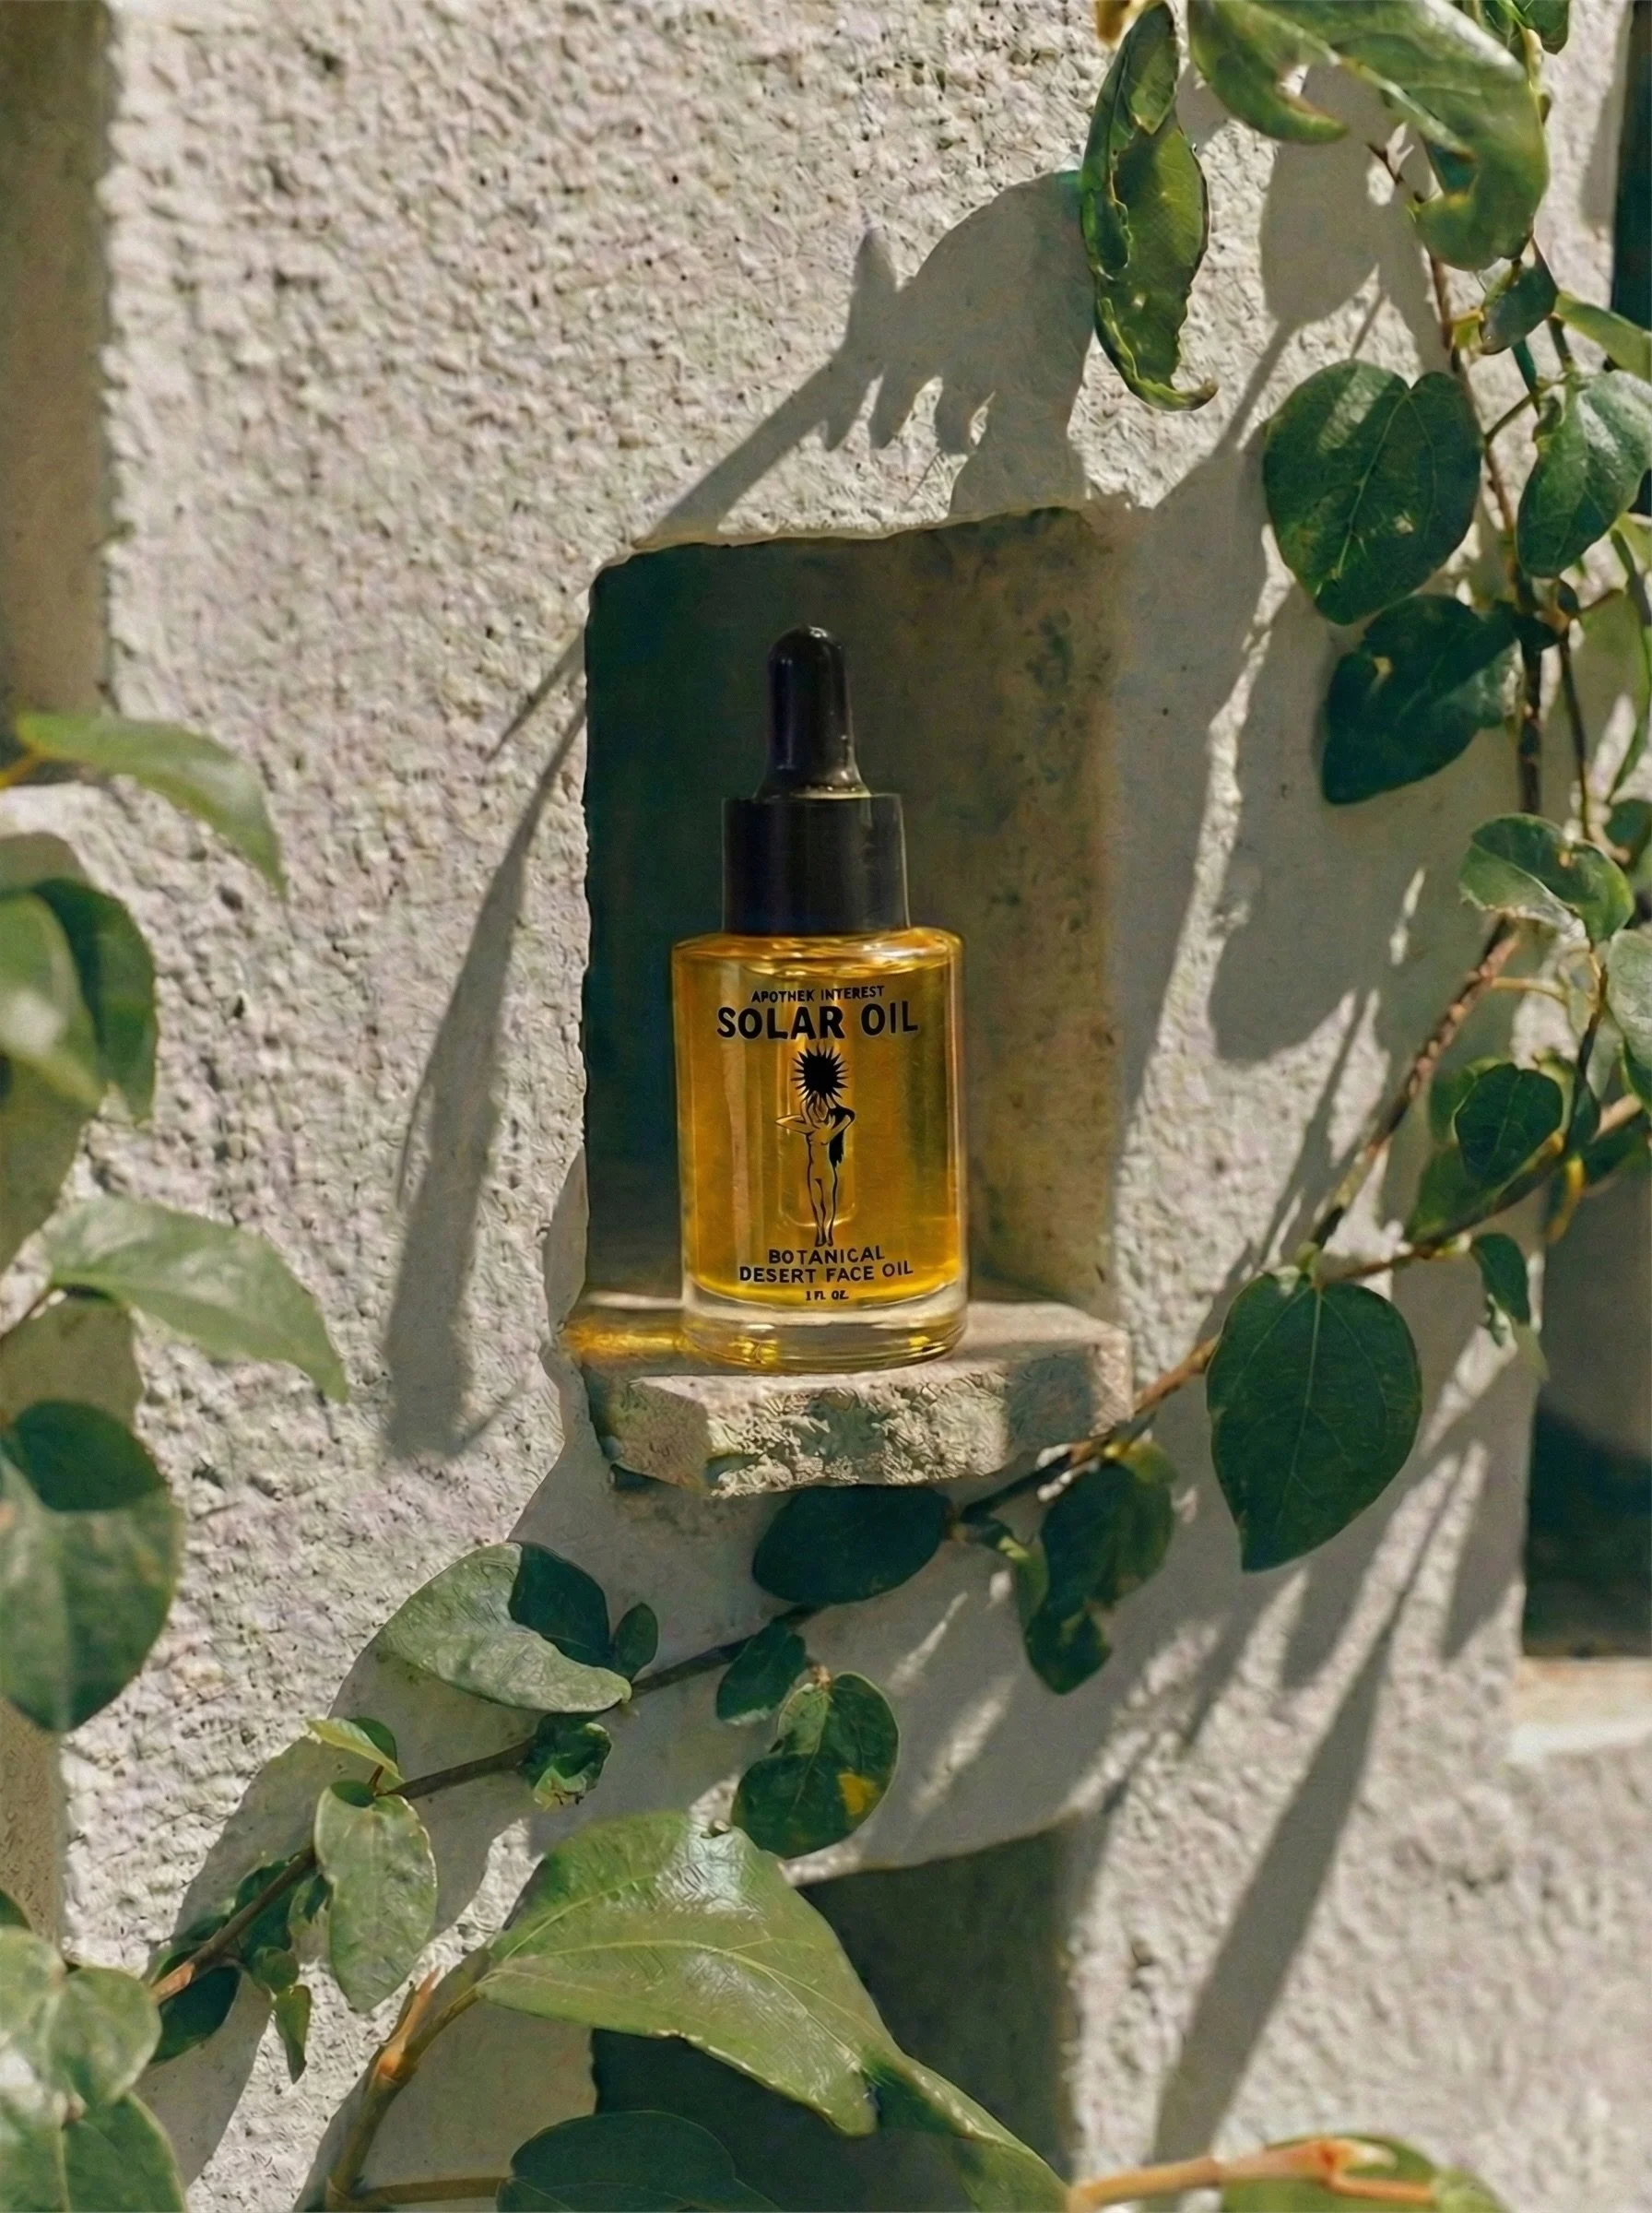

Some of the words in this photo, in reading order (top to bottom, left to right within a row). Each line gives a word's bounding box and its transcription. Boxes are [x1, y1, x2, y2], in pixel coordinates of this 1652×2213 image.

[751, 989, 815, 1003] APOTHEK
[820, 986, 885, 1000] INTEREST
[716, 1006, 845, 1040] SOLAR
[860, 1000, 918, 1036] OIL
[768, 1246, 885, 1265] BOTANICAL
[739, 1266, 817, 1284] DESERT
[826, 1266, 875, 1283] FACE
[881, 1260, 914, 1278] OIL
